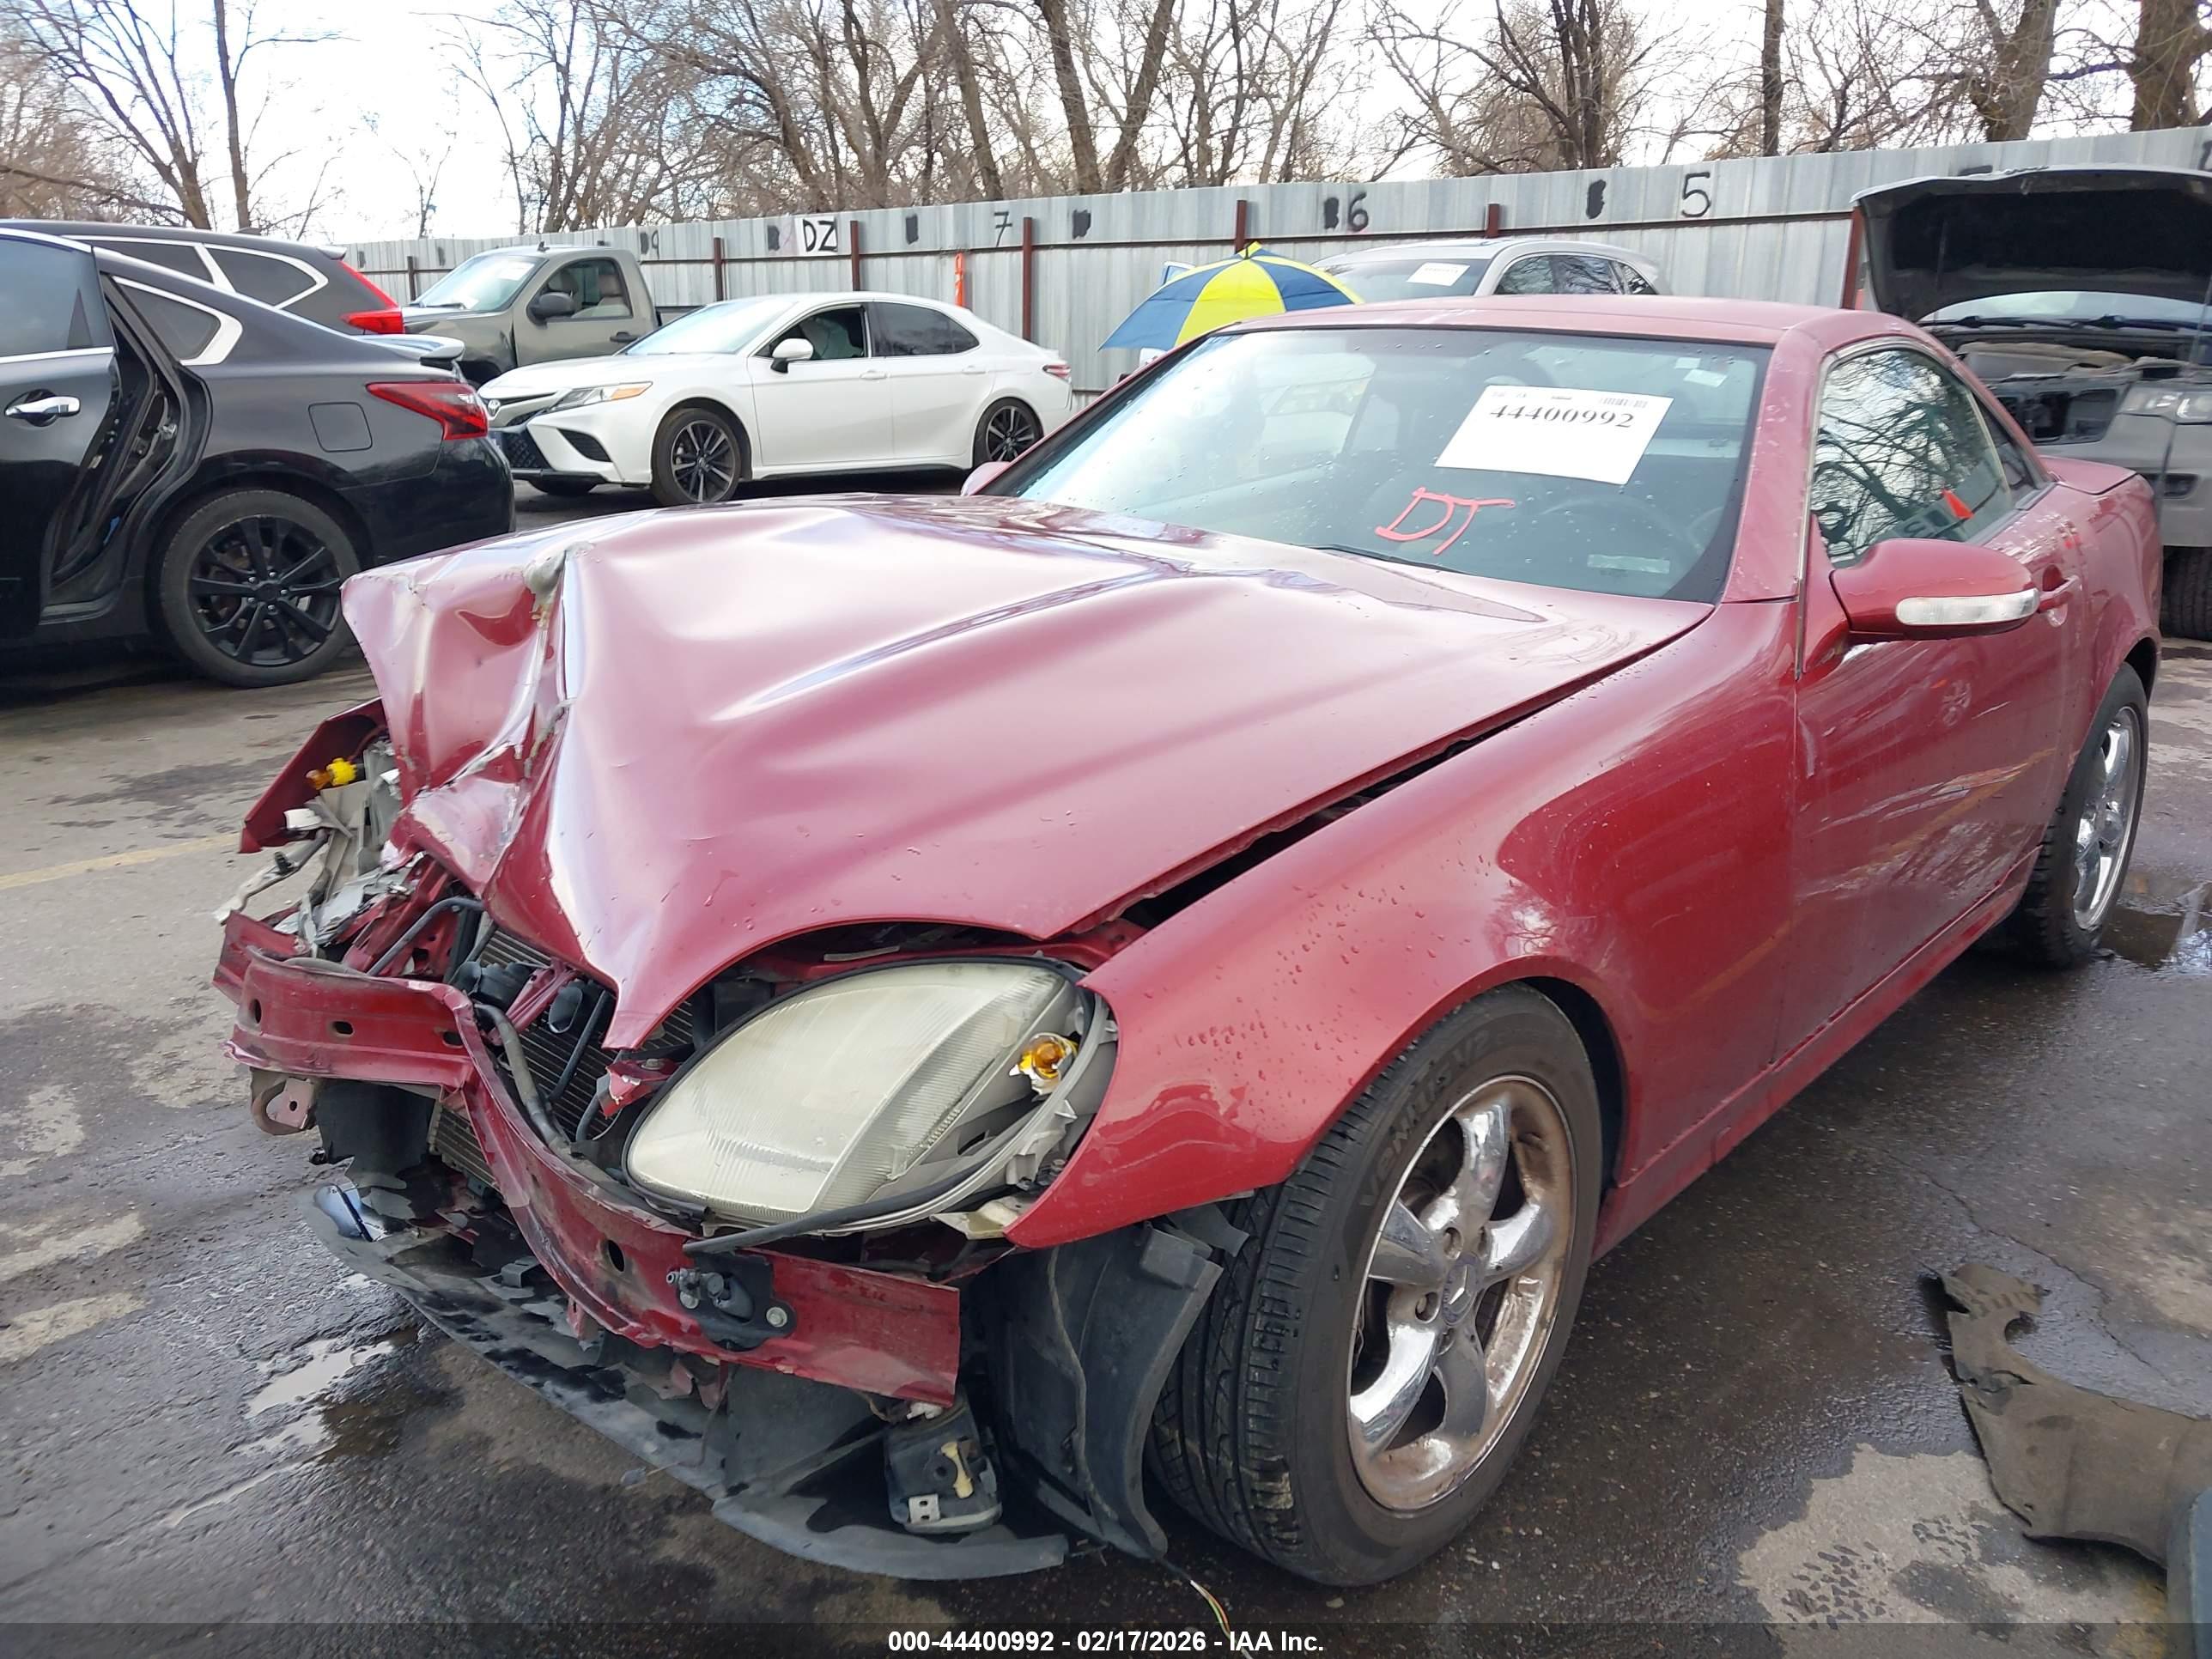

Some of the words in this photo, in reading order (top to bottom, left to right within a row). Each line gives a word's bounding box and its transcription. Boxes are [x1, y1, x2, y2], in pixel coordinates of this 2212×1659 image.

[1681, 171, 1712, 218] 5
[1490, 404, 1635, 428] 44400992
[1374, 486, 1516, 556] DT
